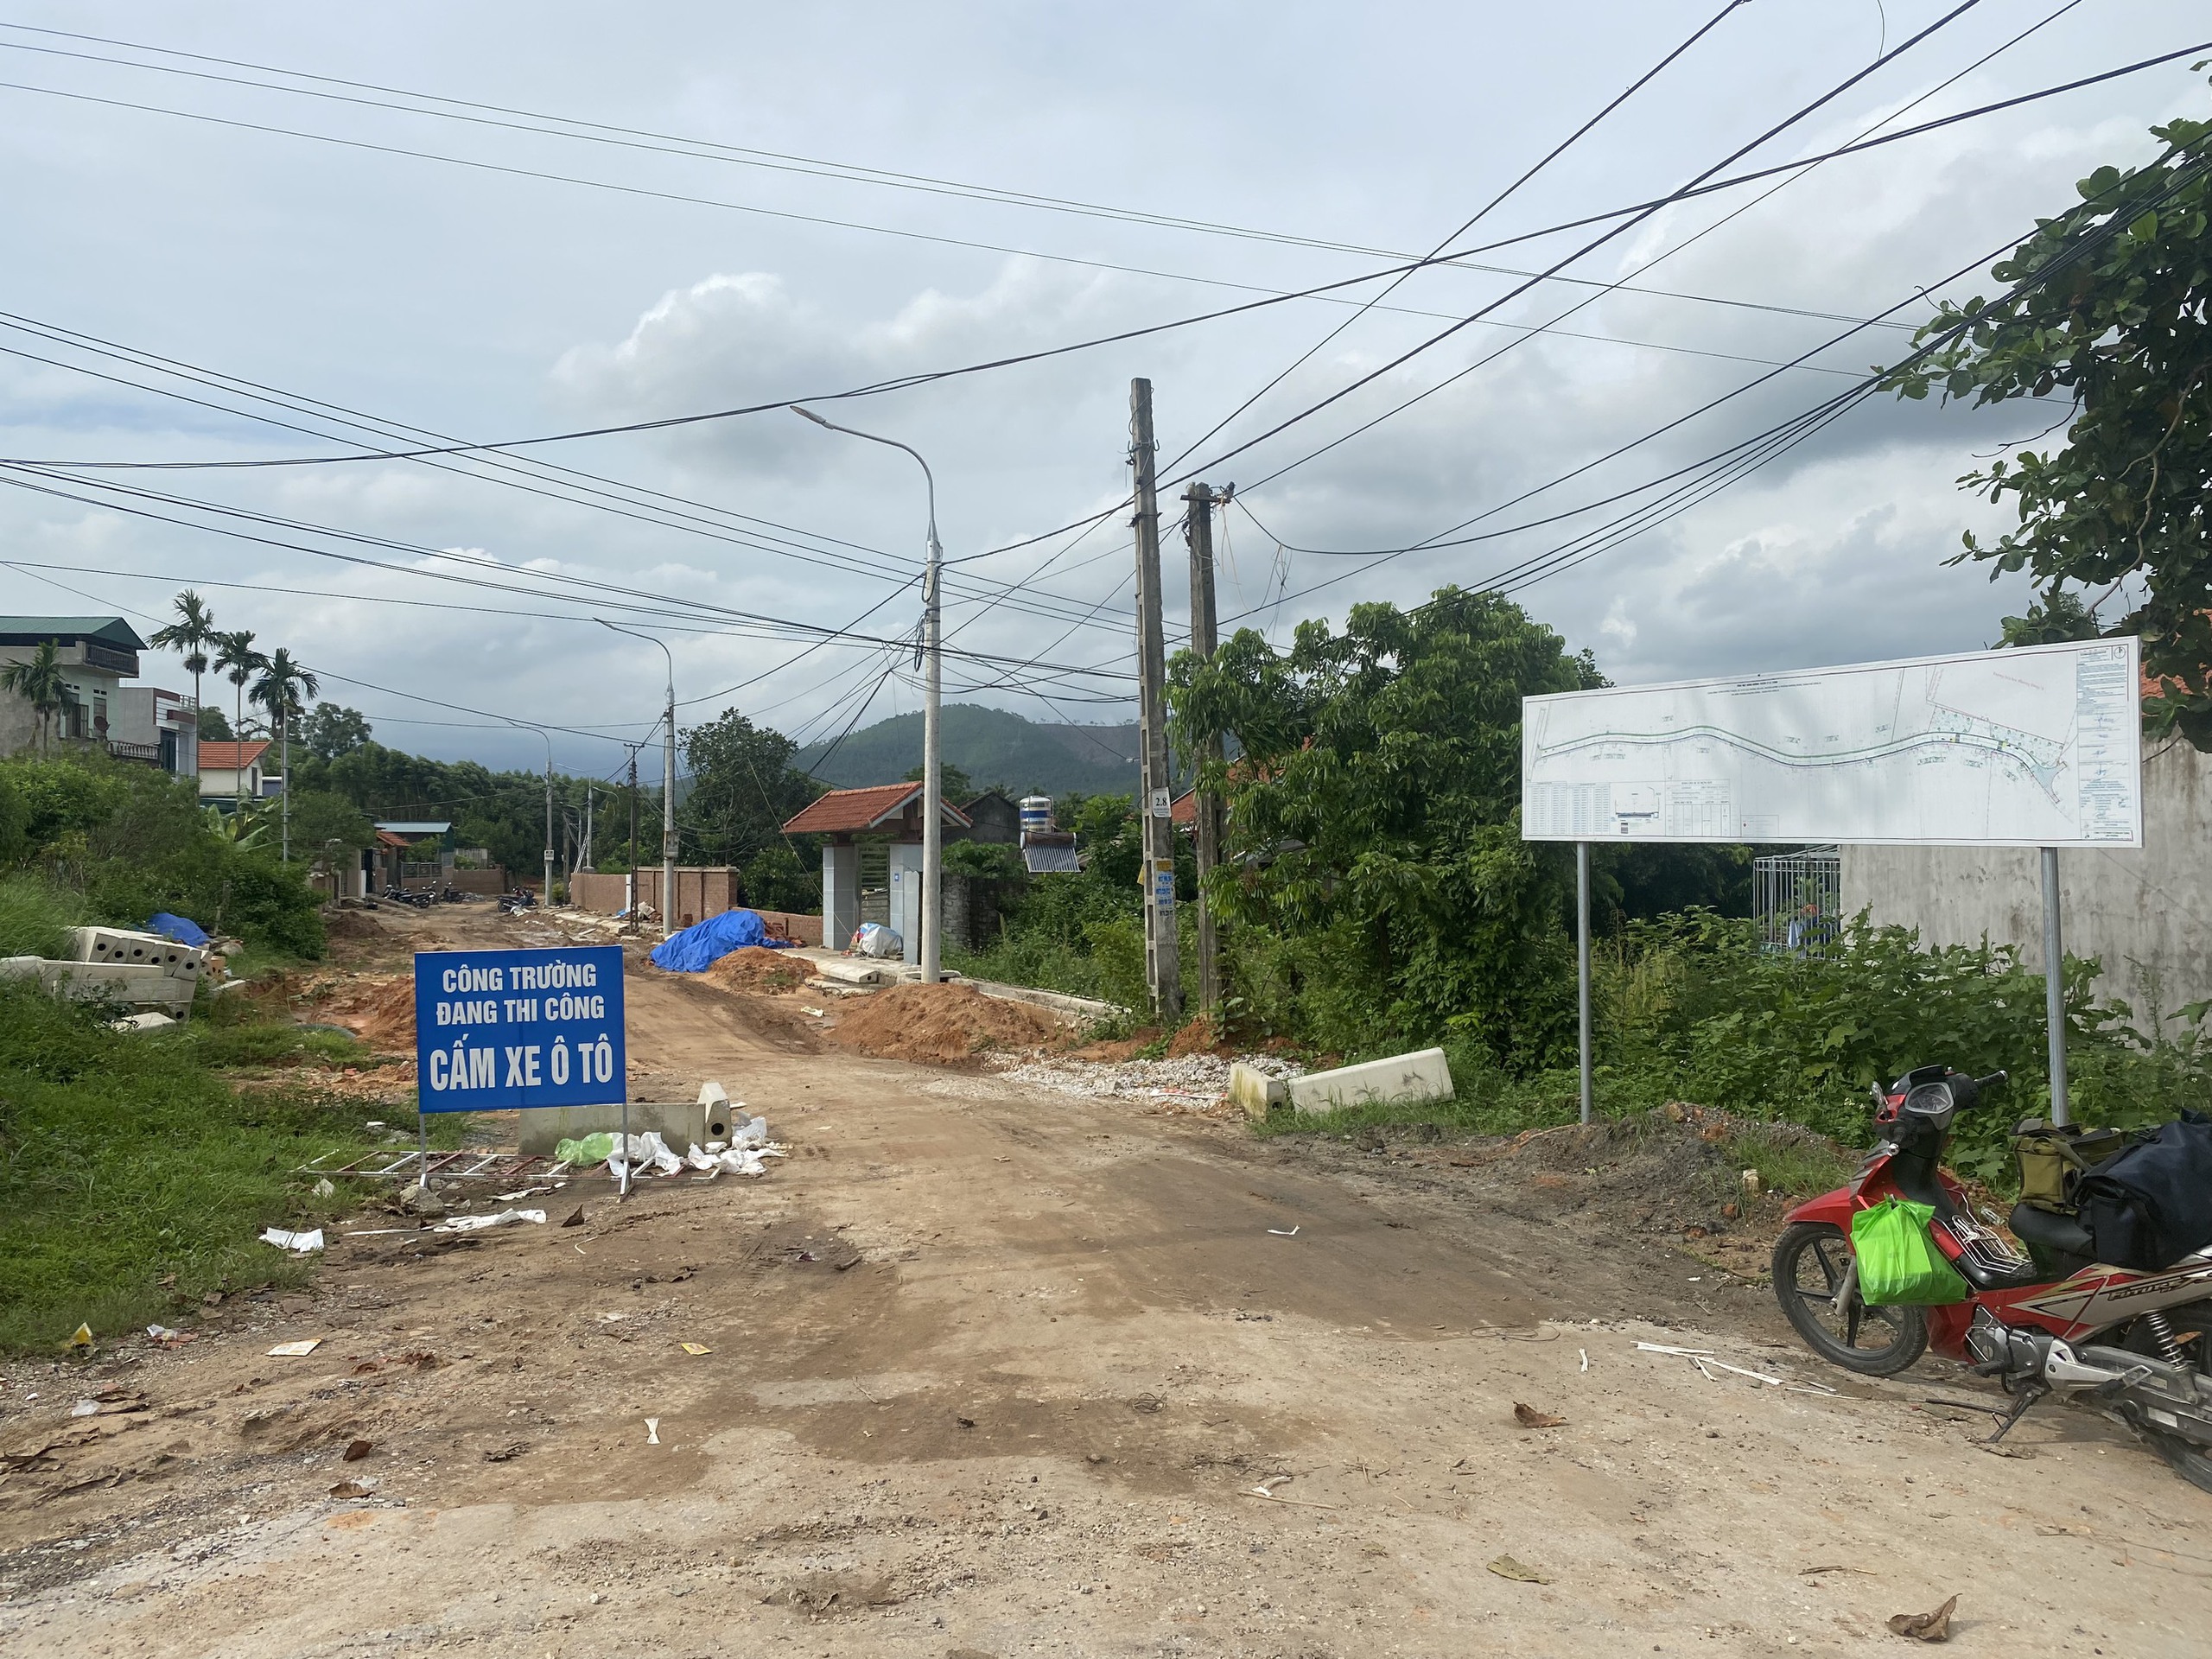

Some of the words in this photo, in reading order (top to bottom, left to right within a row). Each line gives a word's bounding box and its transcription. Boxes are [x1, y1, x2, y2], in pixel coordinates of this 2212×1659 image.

[1155, 797, 1167, 806] 2.8
[442, 963, 504, 993] CÔNG
[509, 960, 597, 990] TRƯỜNG
[436, 1000, 499, 1026] ĐANG
[504, 998, 537, 1023] THI
[544, 992, 605, 1021] CÔNG
[429, 1033, 496, 1091] CẤM
[505, 1046, 542, 1087] XE
[550, 1035, 569, 1086] Ô
[578, 1033, 613, 1084] TÔ
